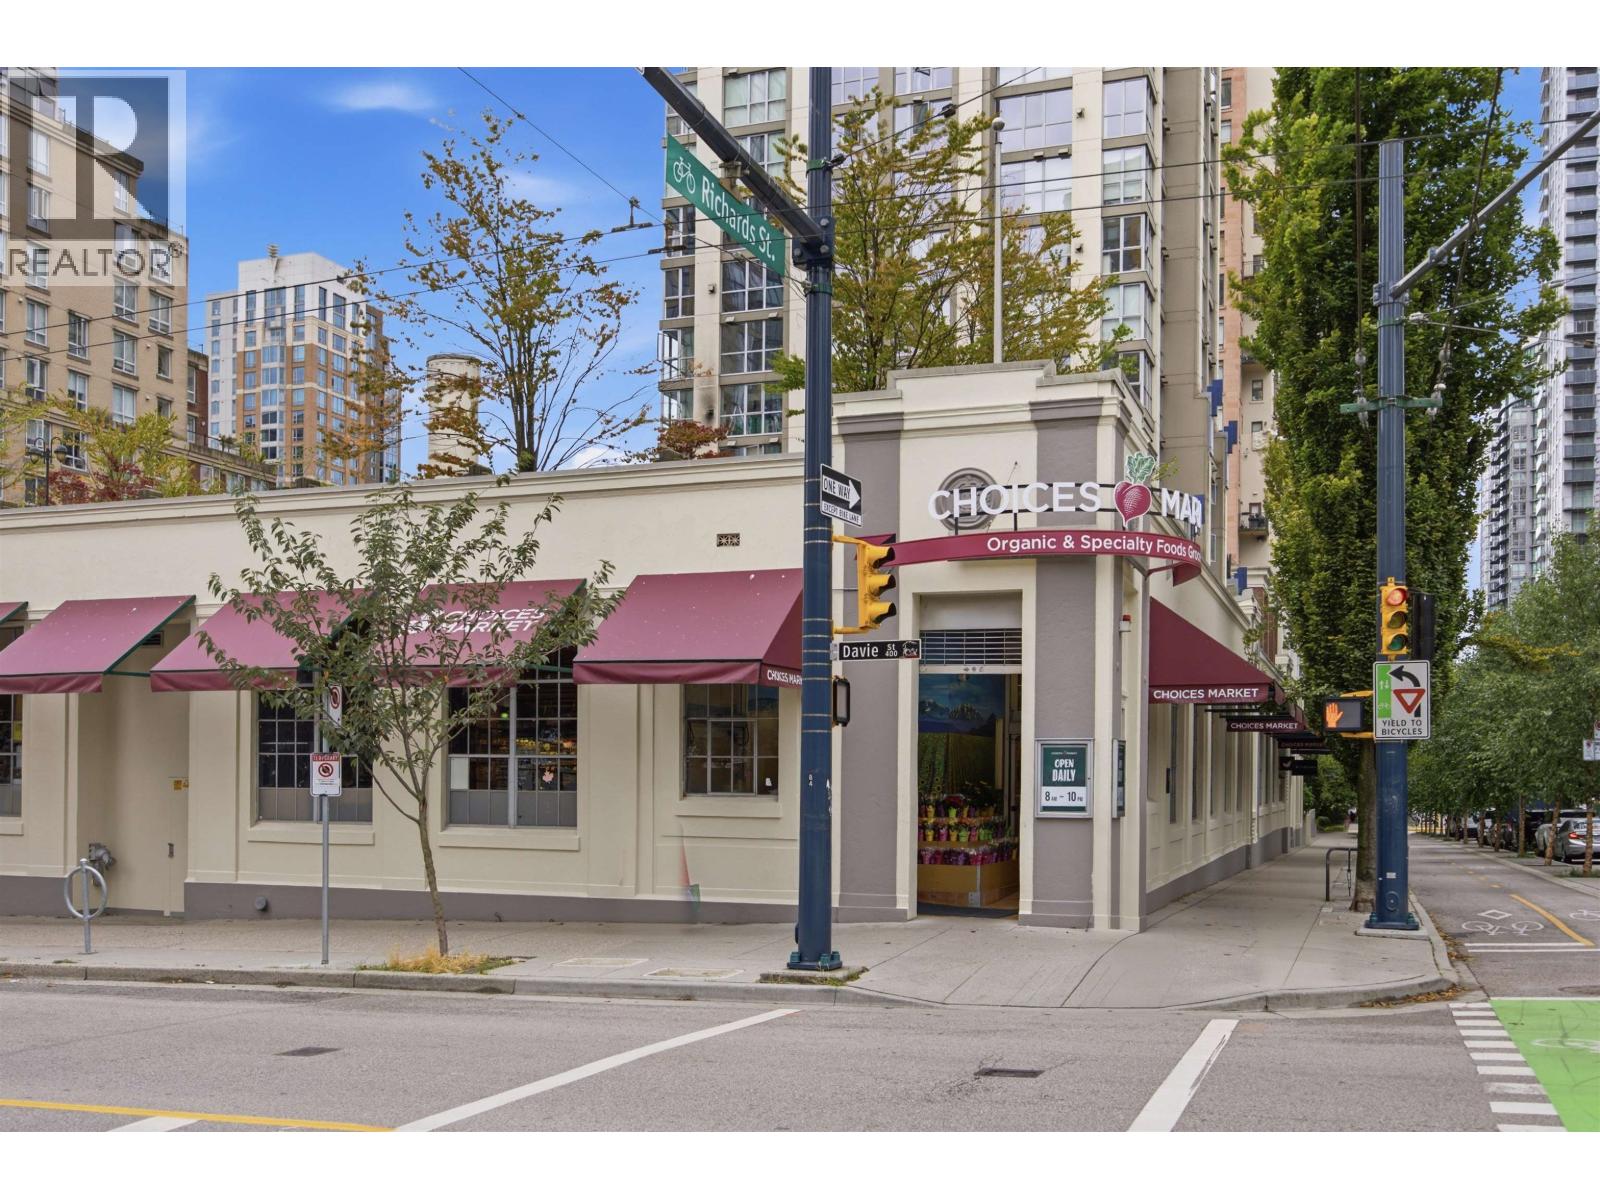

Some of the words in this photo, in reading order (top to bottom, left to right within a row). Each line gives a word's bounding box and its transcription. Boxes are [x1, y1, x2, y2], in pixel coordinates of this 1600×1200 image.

[701, 175, 756, 246] Richards
[758, 226, 775, 262] St.
[823, 477, 836, 495] ONE
[837, 484, 851, 501] WAY
[928, 481, 1101, 520] CHOICES
[987, 535, 1057, 553] Organic
[1062, 535, 1075, 549] &
[1080, 535, 1153, 554] Specialty
[1156, 539, 1187, 557] Foods
[843, 643, 879, 658] Davie
[1153, 689, 1205, 700] CHOICES
[1208, 688, 1260, 698] MARKET
[1230, 722, 1265, 730] CHOICES
[1381, 728, 1423, 736] BICYCLES
[1054, 759, 1074, 768] OPEN
[1052, 769, 1076, 781] DAILY
[1045, 791, 1050, 801] 8
[1067, 791, 1076, 801] 10
